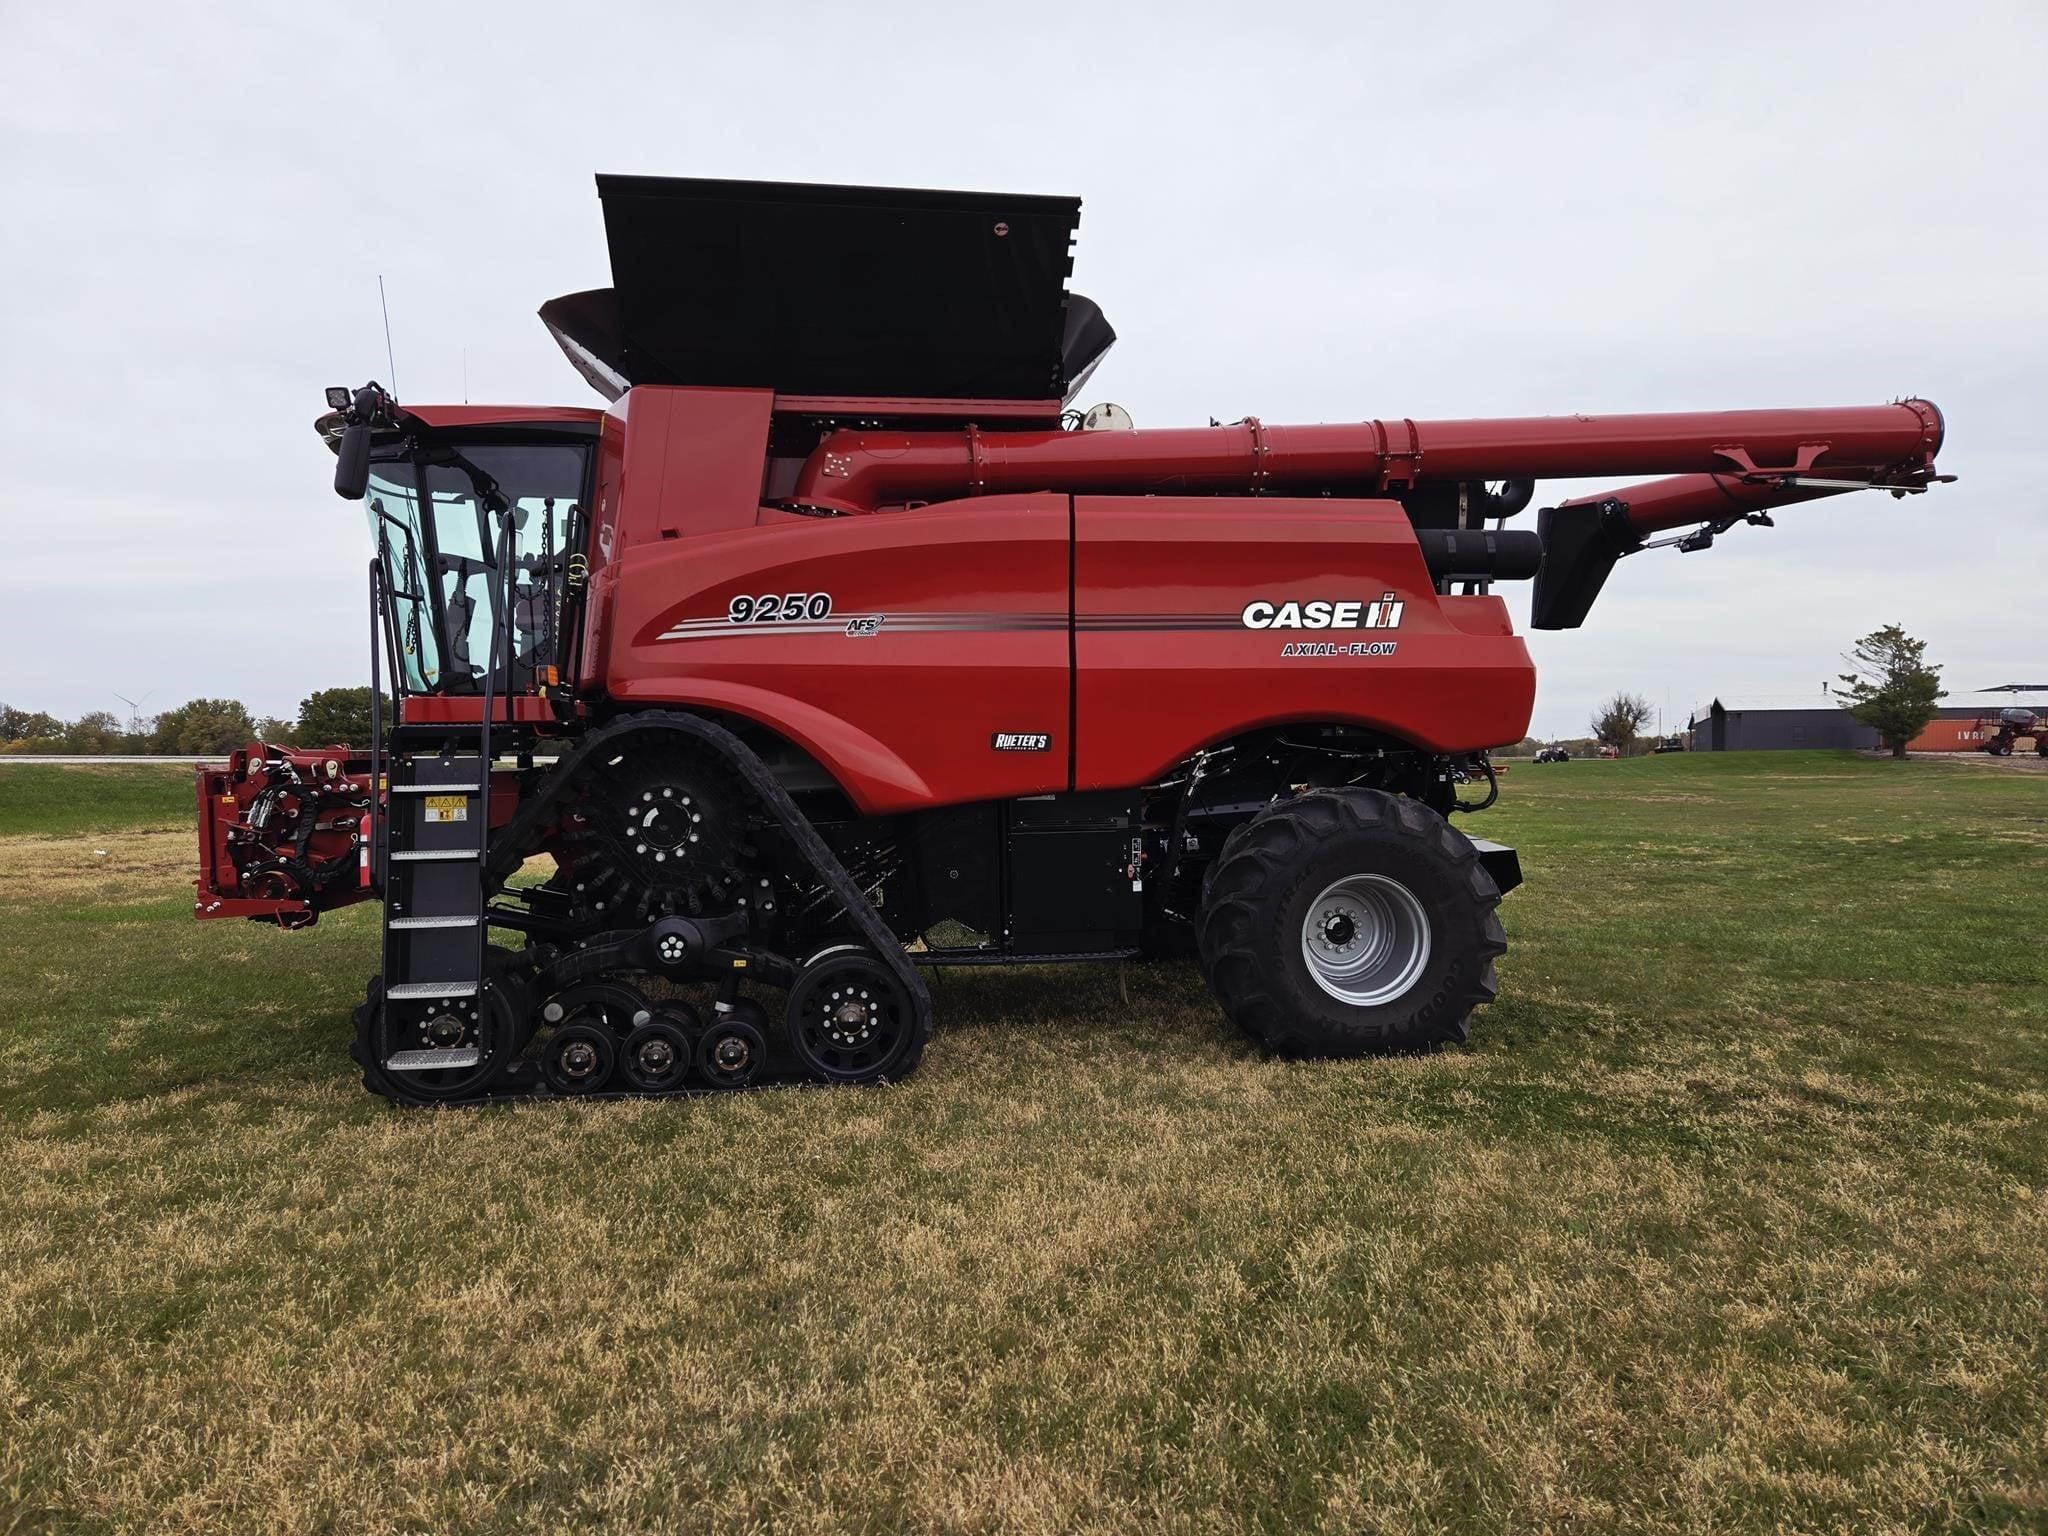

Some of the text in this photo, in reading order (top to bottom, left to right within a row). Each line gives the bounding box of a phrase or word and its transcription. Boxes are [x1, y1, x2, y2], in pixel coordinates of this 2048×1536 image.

[729, 592, 832, 625] 9250
[1242, 601, 1362, 629] CASE
[846, 618, 879, 631] AFS
[1281, 642, 1396, 656] AXIAL-FLOW
[995, 734, 1047, 748] RUETER'S
[1321, 957, 1465, 1040] GOODYEAR
